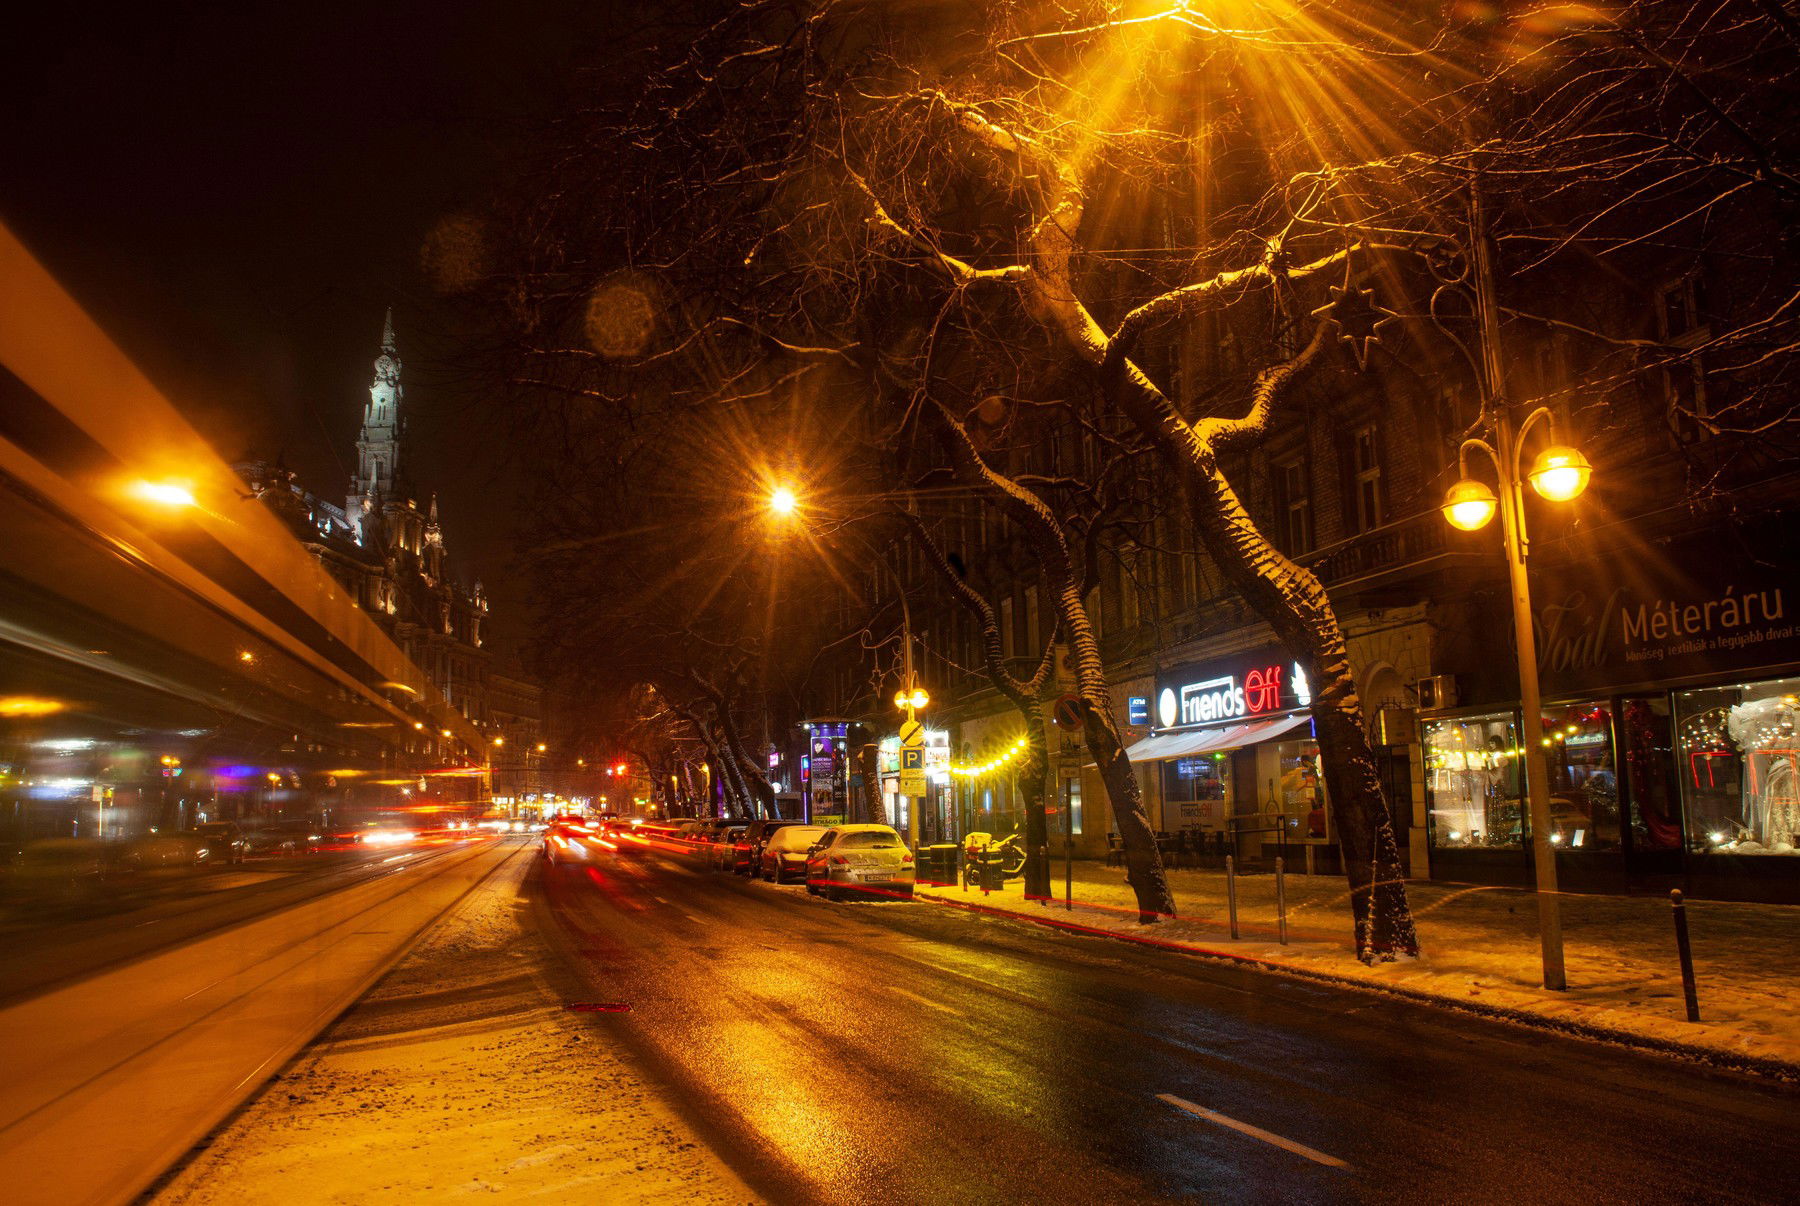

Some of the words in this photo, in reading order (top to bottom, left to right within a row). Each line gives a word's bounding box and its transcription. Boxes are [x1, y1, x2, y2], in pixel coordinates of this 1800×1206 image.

[1621, 585, 1783, 645] Méteráru
[1181, 675, 1245, 724] Friends
[1245, 665, 1281, 713] Off
[907, 751, 918, 767] P
